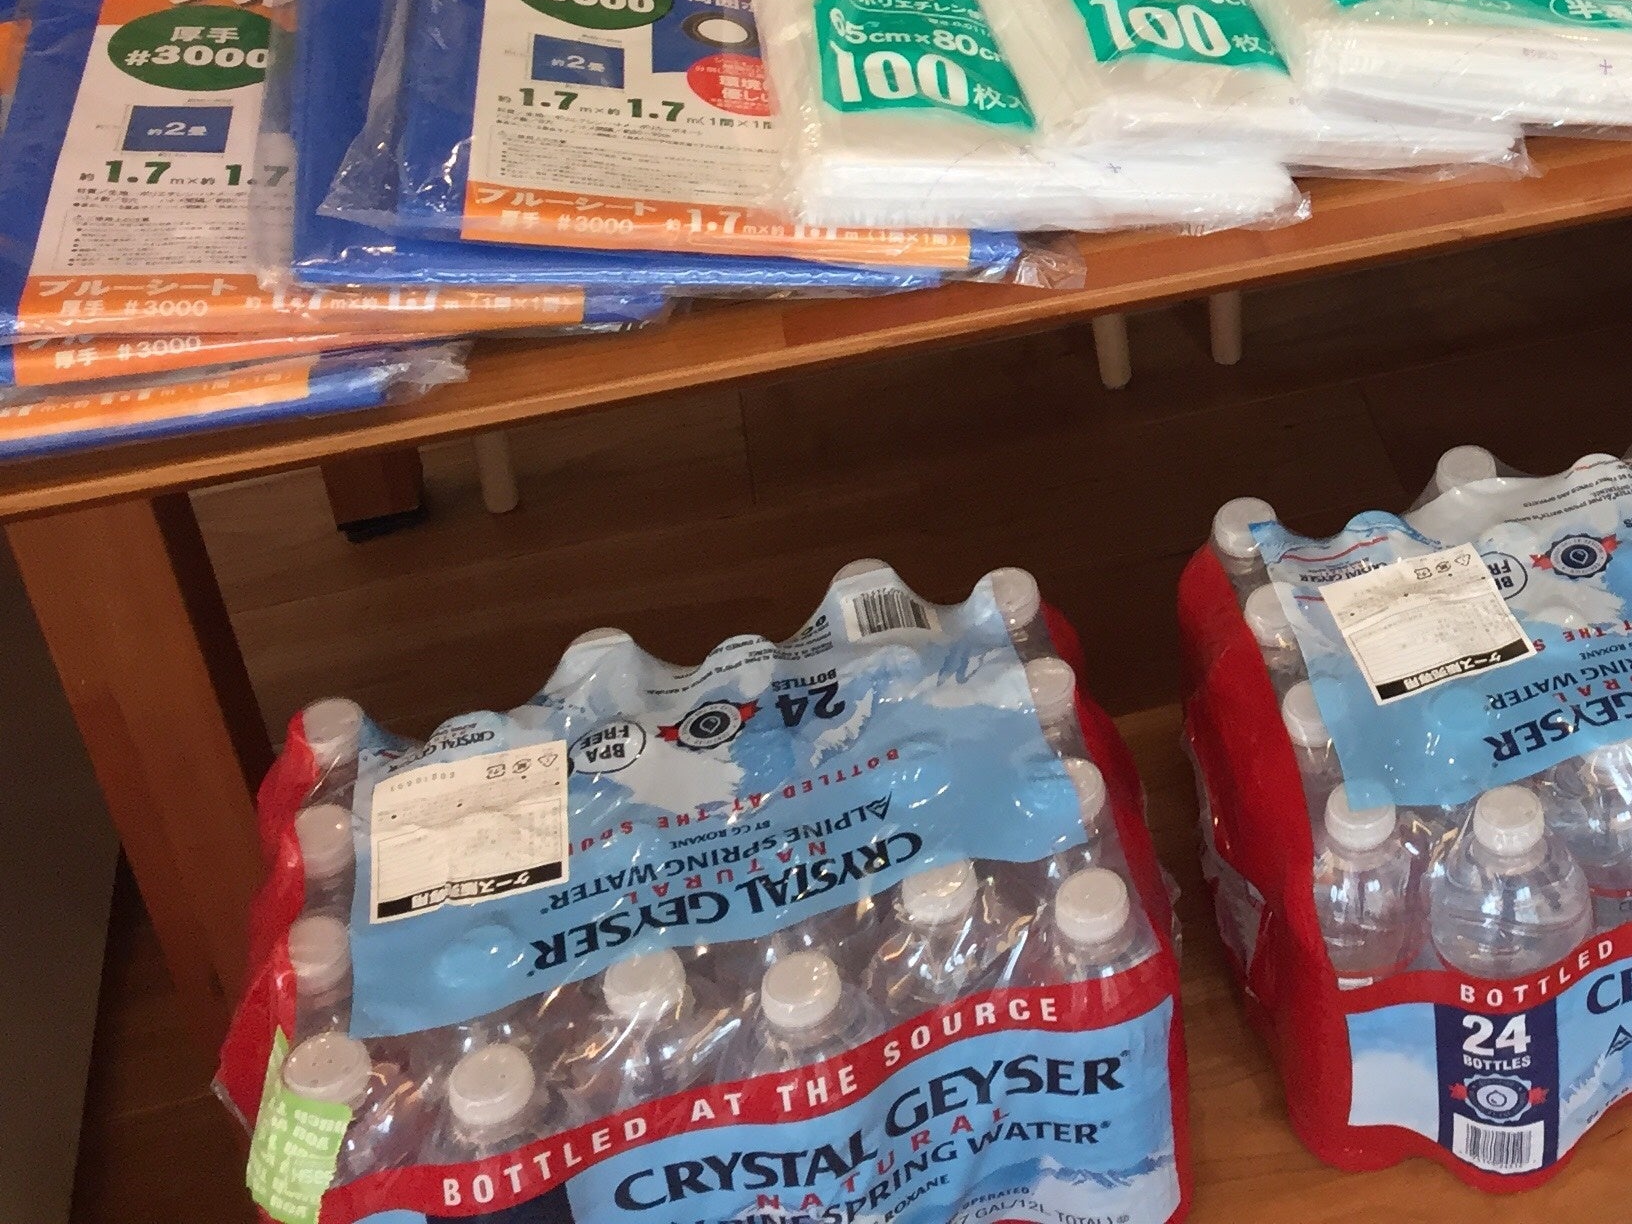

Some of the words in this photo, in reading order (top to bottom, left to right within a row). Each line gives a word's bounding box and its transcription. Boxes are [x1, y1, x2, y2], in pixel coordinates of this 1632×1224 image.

[170, 26, 240, 43] 厚手
[124, 45, 274, 68] #3000
[832, 41, 969, 108] 100
[474, 188, 658, 216] ブルーシート
[500, 211, 540, 229] 厚手
[557, 215, 634, 234] #3000
[39, 278, 237, 296] ブルーシート
[60, 299, 105, 316] 厚手
[123, 299, 208, 317] #3000
[1563, 626, 1607, 643] THE
[1579, 644, 1626, 659] ROXANE
[770, 667, 839, 692] BOTTLES
[1488, 663, 1582, 709] WATER
[771, 678, 846, 730] 24
[585, 743, 626, 763] BPA
[782, 748, 901, 801] BOTTLED
[656, 807, 710, 831] THE
[785, 790, 893, 846] ALPINE
[668, 831, 722, 851] ROXANE
[730, 831, 924, 925] CRYSTAL
[530, 887, 728, 974] GEYSER
[1459, 940, 1614, 1005] BOTTLED
[1461, 1014, 1532, 1058] 24
[1461, 1054, 1532, 1071] BOTTLES
[441, 1116, 648, 1208] BOTTLED
[689, 1092, 742, 1125] AT
[775, 1058, 860, 1111] THE
[882, 993, 1061, 1068] SOURCE
[613, 1127, 880, 1211] CRYSTAL
[883, 1054, 1125, 1138] GEYSER
[755, 1108, 1009, 1210] NATURAL
[819, 1139, 959, 1224] SPRING
[969, 1119, 1102, 1157] WATER
